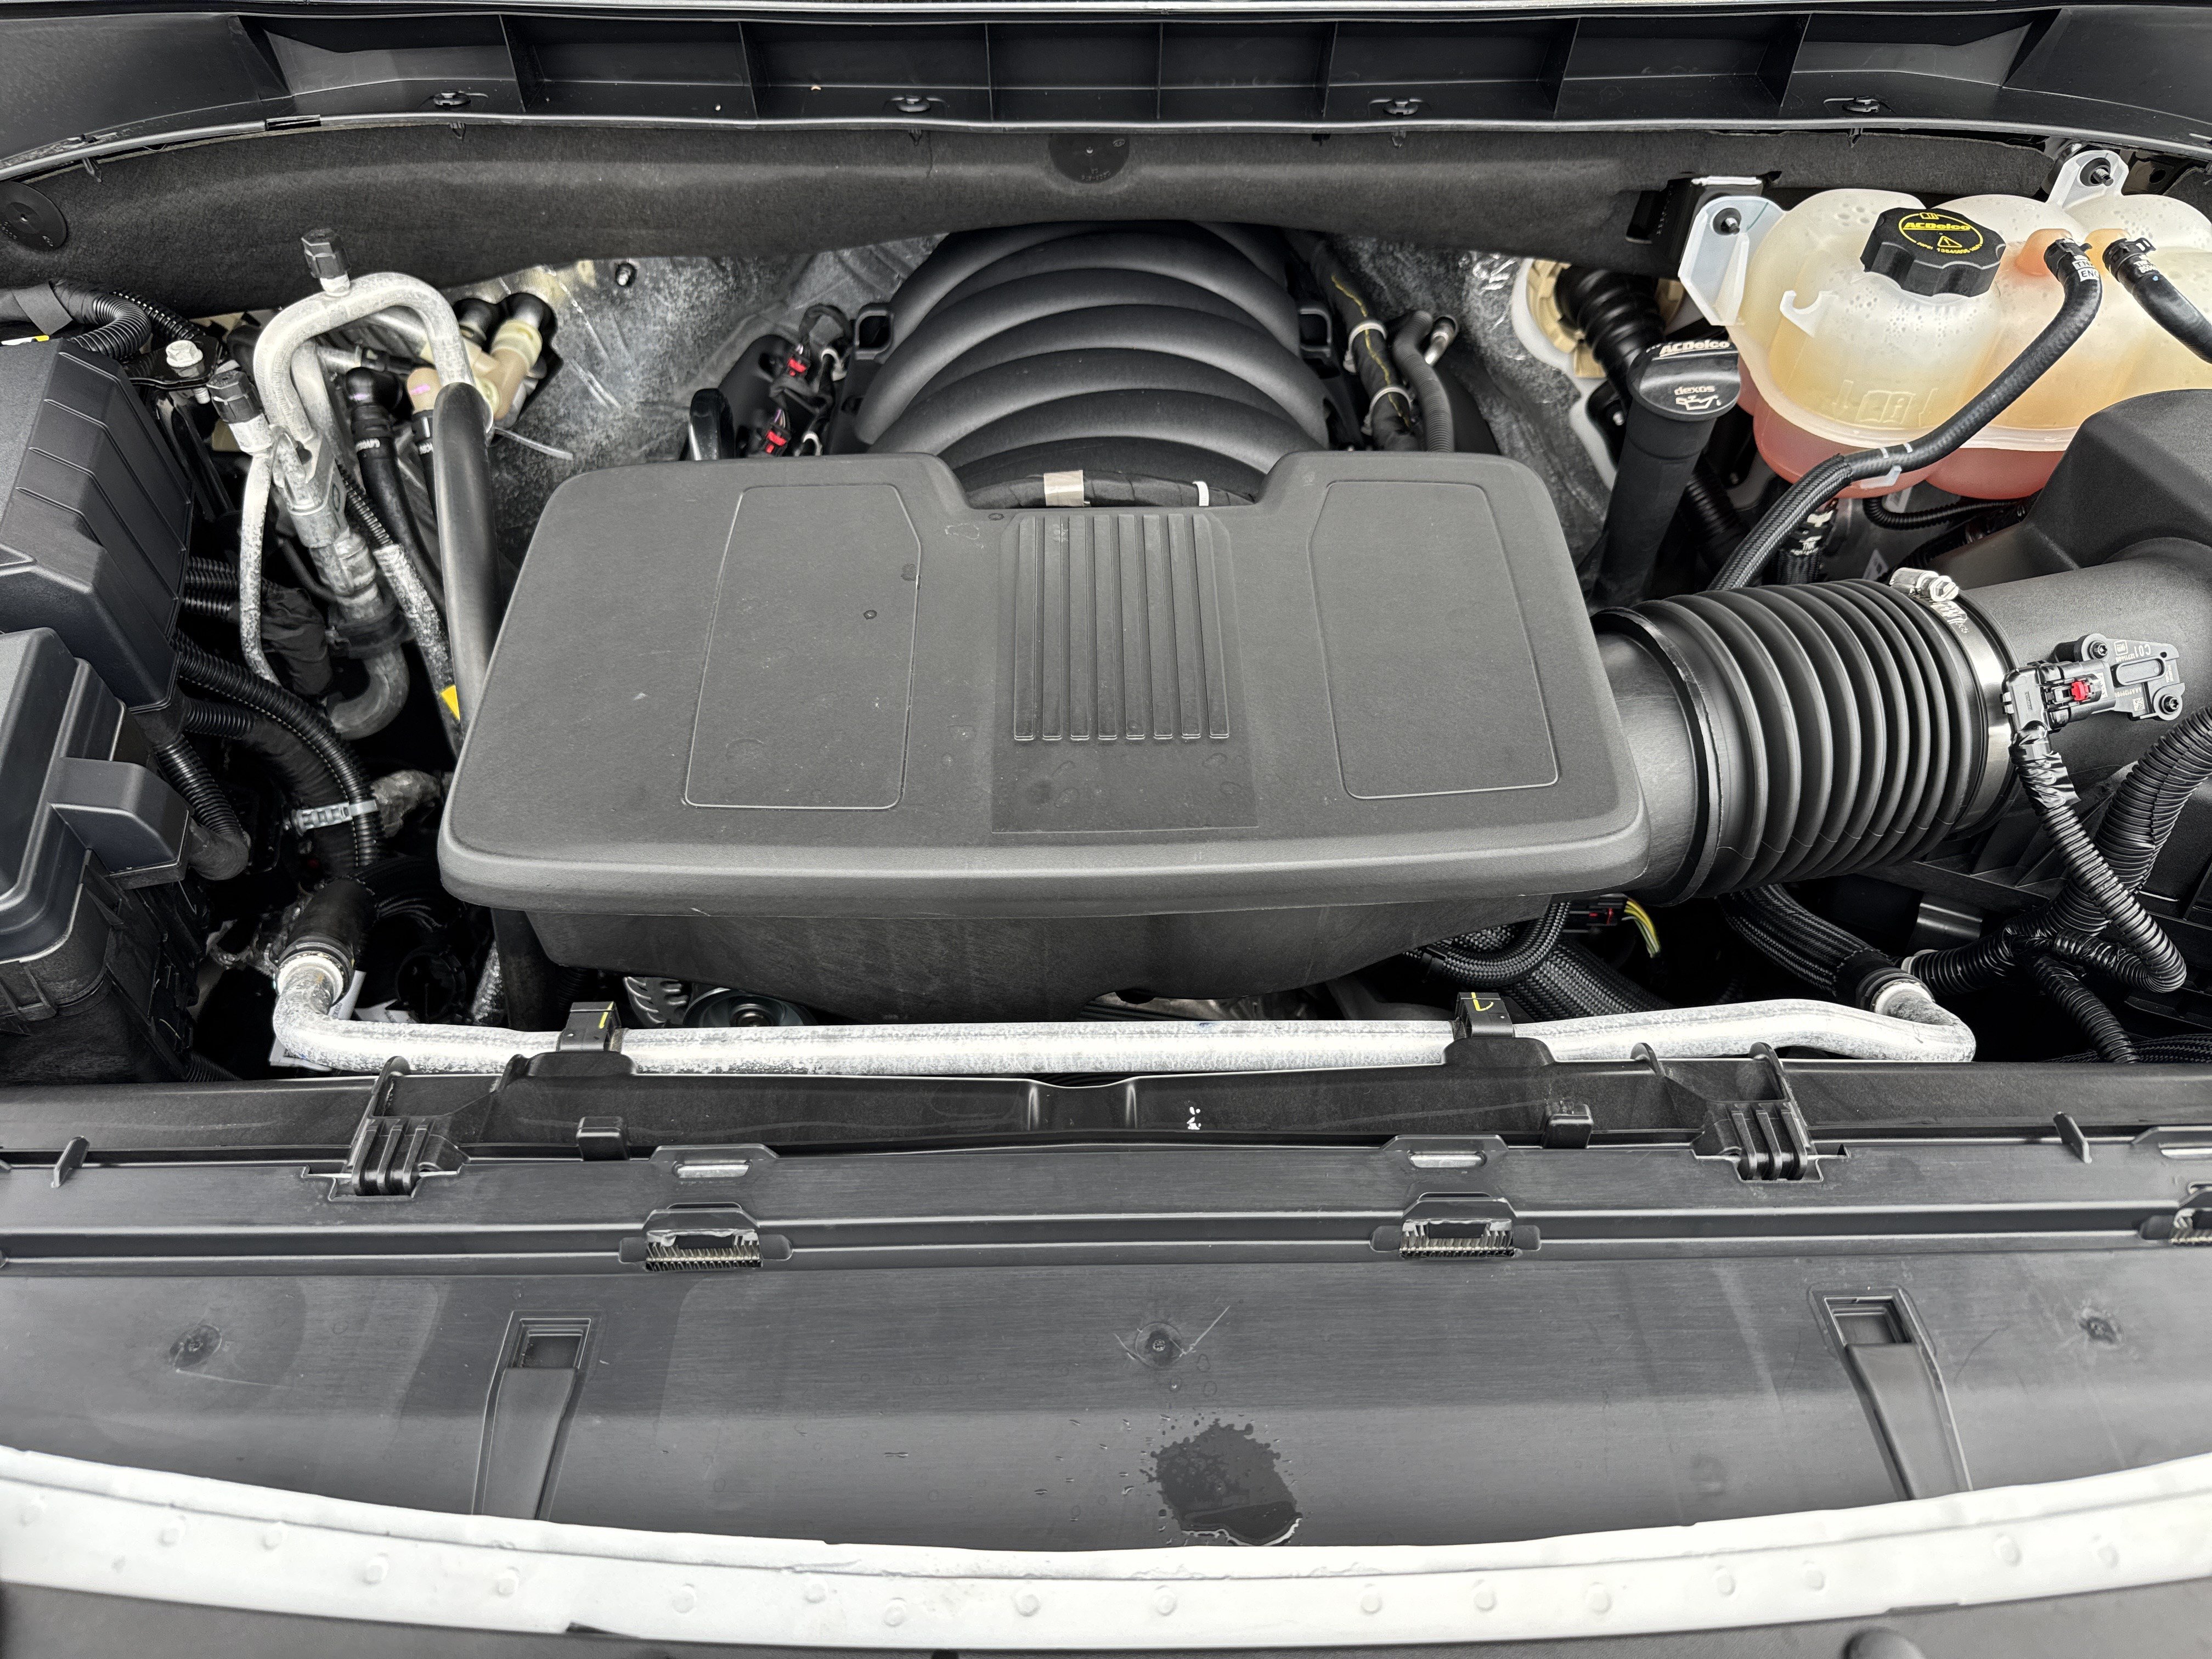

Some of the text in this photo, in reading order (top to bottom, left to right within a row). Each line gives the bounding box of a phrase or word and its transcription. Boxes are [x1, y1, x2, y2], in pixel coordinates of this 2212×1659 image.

[1904, 222, 1971, 230] ACDelco
[1659, 339, 1730, 356] ACDelco
[1674, 386, 1715, 395] dexos
